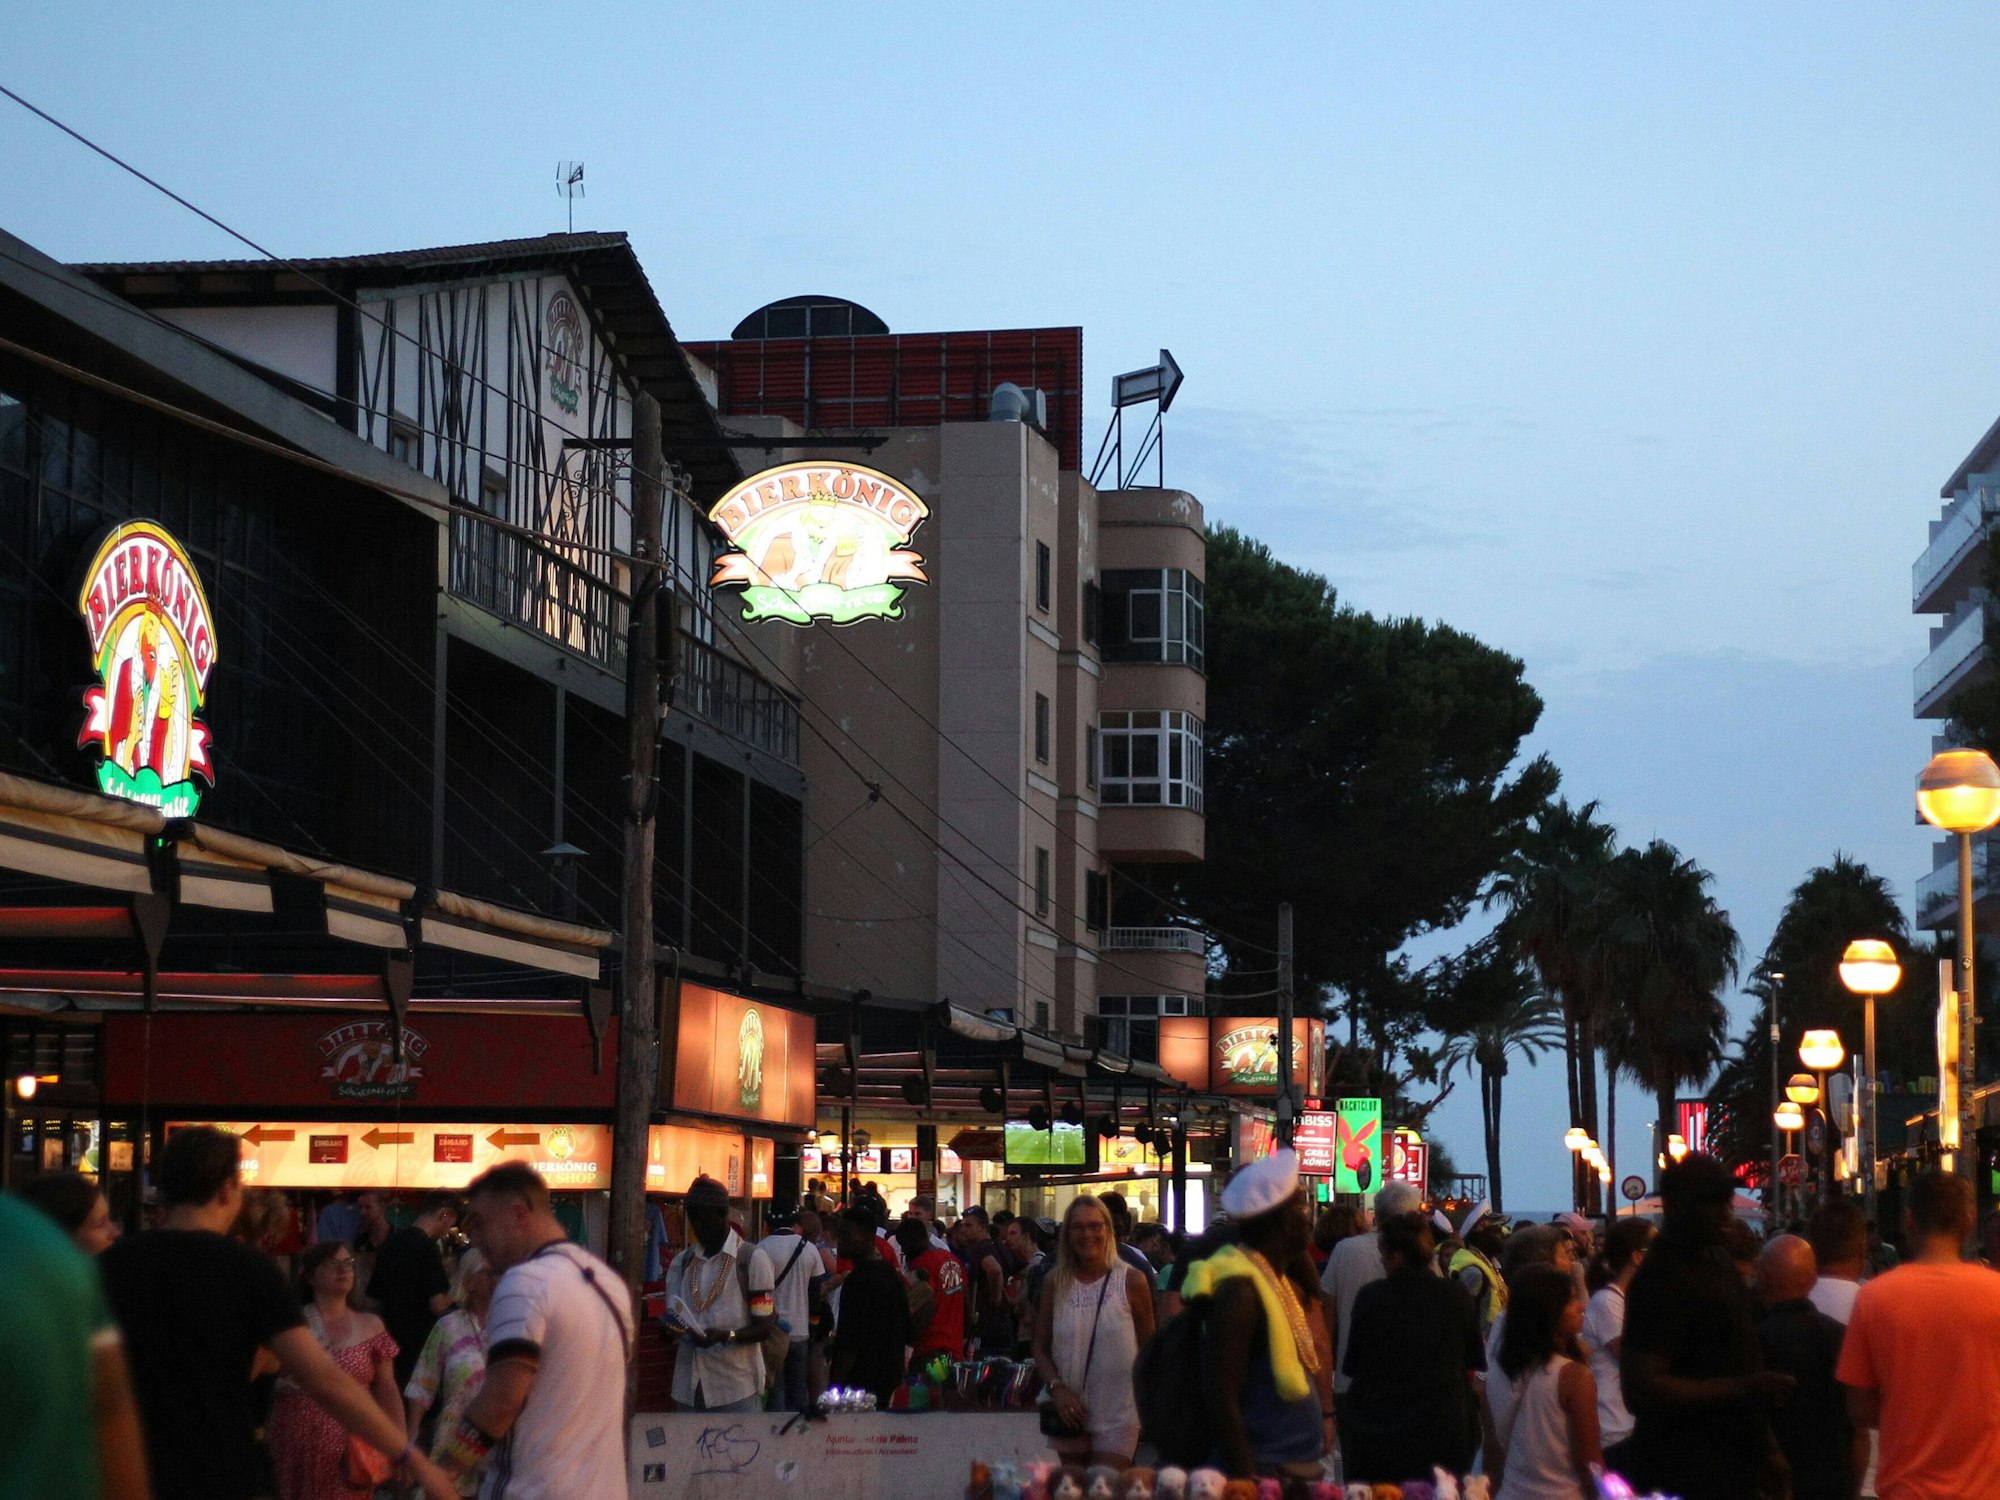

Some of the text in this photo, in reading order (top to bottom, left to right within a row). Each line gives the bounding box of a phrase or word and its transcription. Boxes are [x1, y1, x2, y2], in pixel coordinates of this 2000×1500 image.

[716, 468, 917, 532] BIERKÖNIG
[88, 544, 210, 674] BIERKÖNIG
[1304, 1149, 1330, 1157] GRILL
[530, 1160, 597, 1173] IERKÖNIG
[1303, 1158, 1332, 1167] KÖNIG
[558, 1173, 597, 1184] SHOP
[890, 1434, 919, 1444] Palma
